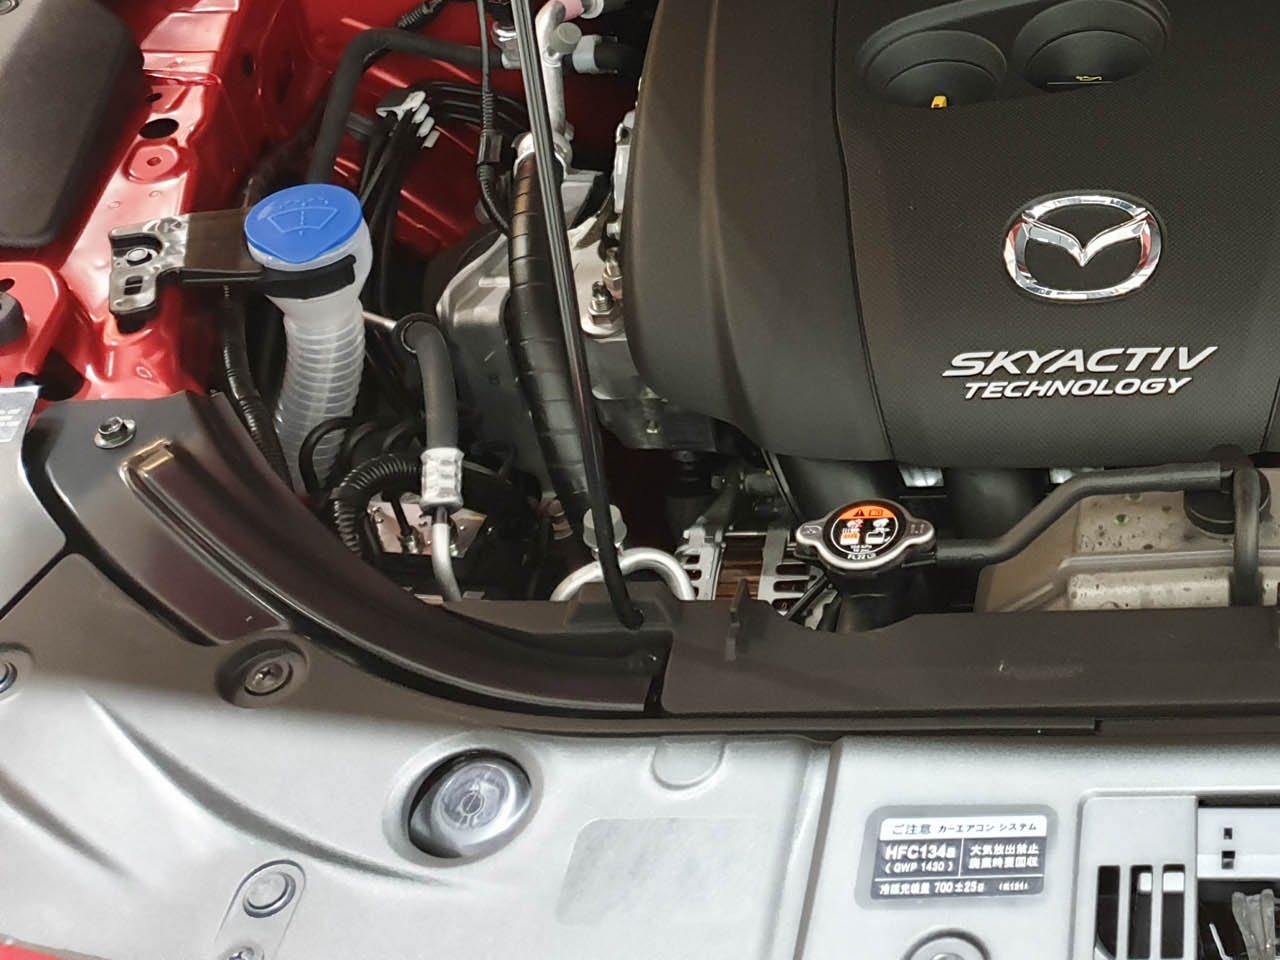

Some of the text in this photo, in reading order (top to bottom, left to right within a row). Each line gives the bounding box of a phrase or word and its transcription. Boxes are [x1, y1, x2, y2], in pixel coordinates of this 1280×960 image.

[942, 346, 1218, 377] SKYACTIV
[965, 377, 1192, 400] TECHNOLOGY
[892, 823, 1037, 835] ご注意 カーエアコン システム
[885, 843, 956, 860] HFC134a
